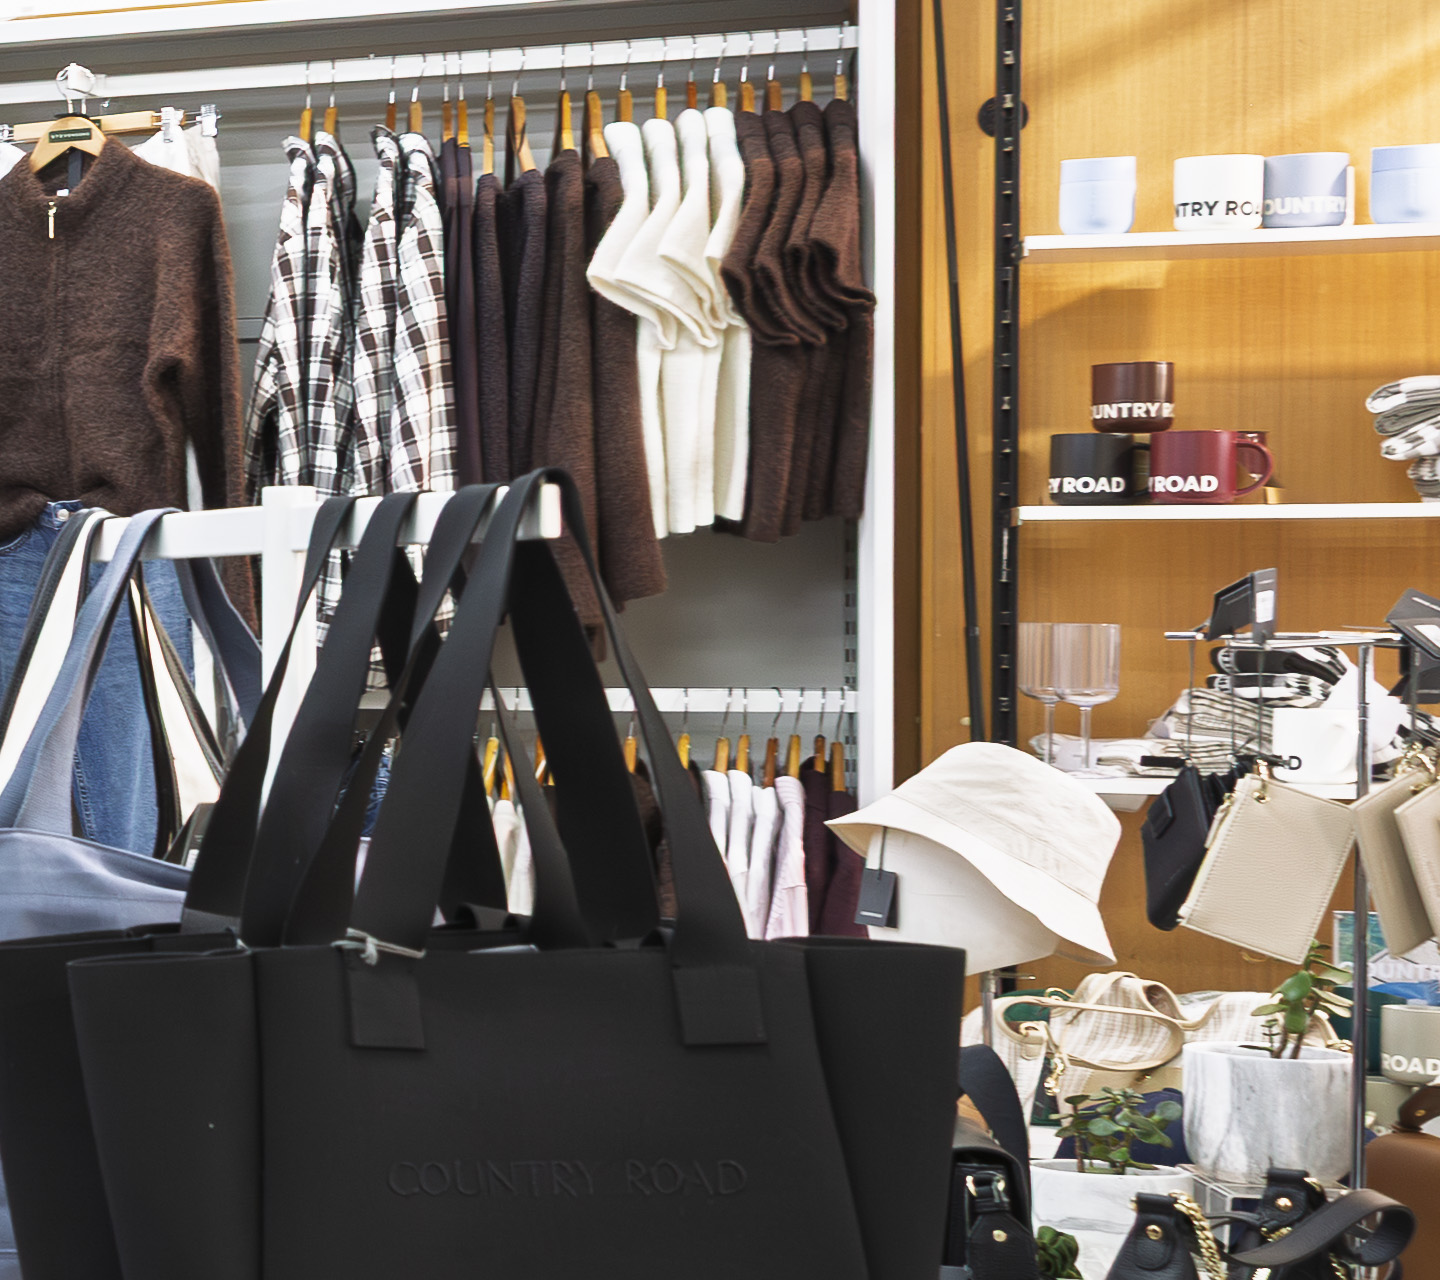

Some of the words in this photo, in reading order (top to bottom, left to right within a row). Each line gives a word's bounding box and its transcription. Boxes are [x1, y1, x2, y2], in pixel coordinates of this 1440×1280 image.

[1091, 402, 1157, 419] UNTRY
[1063, 477, 1126, 494] ROAD
[1154, 475, 1218, 493] ROAD
[1381, 1052, 1440, 1076] ROAD
[387, 1159, 596, 1197] COUNTRY
[625, 1158, 748, 1196] ROAD
